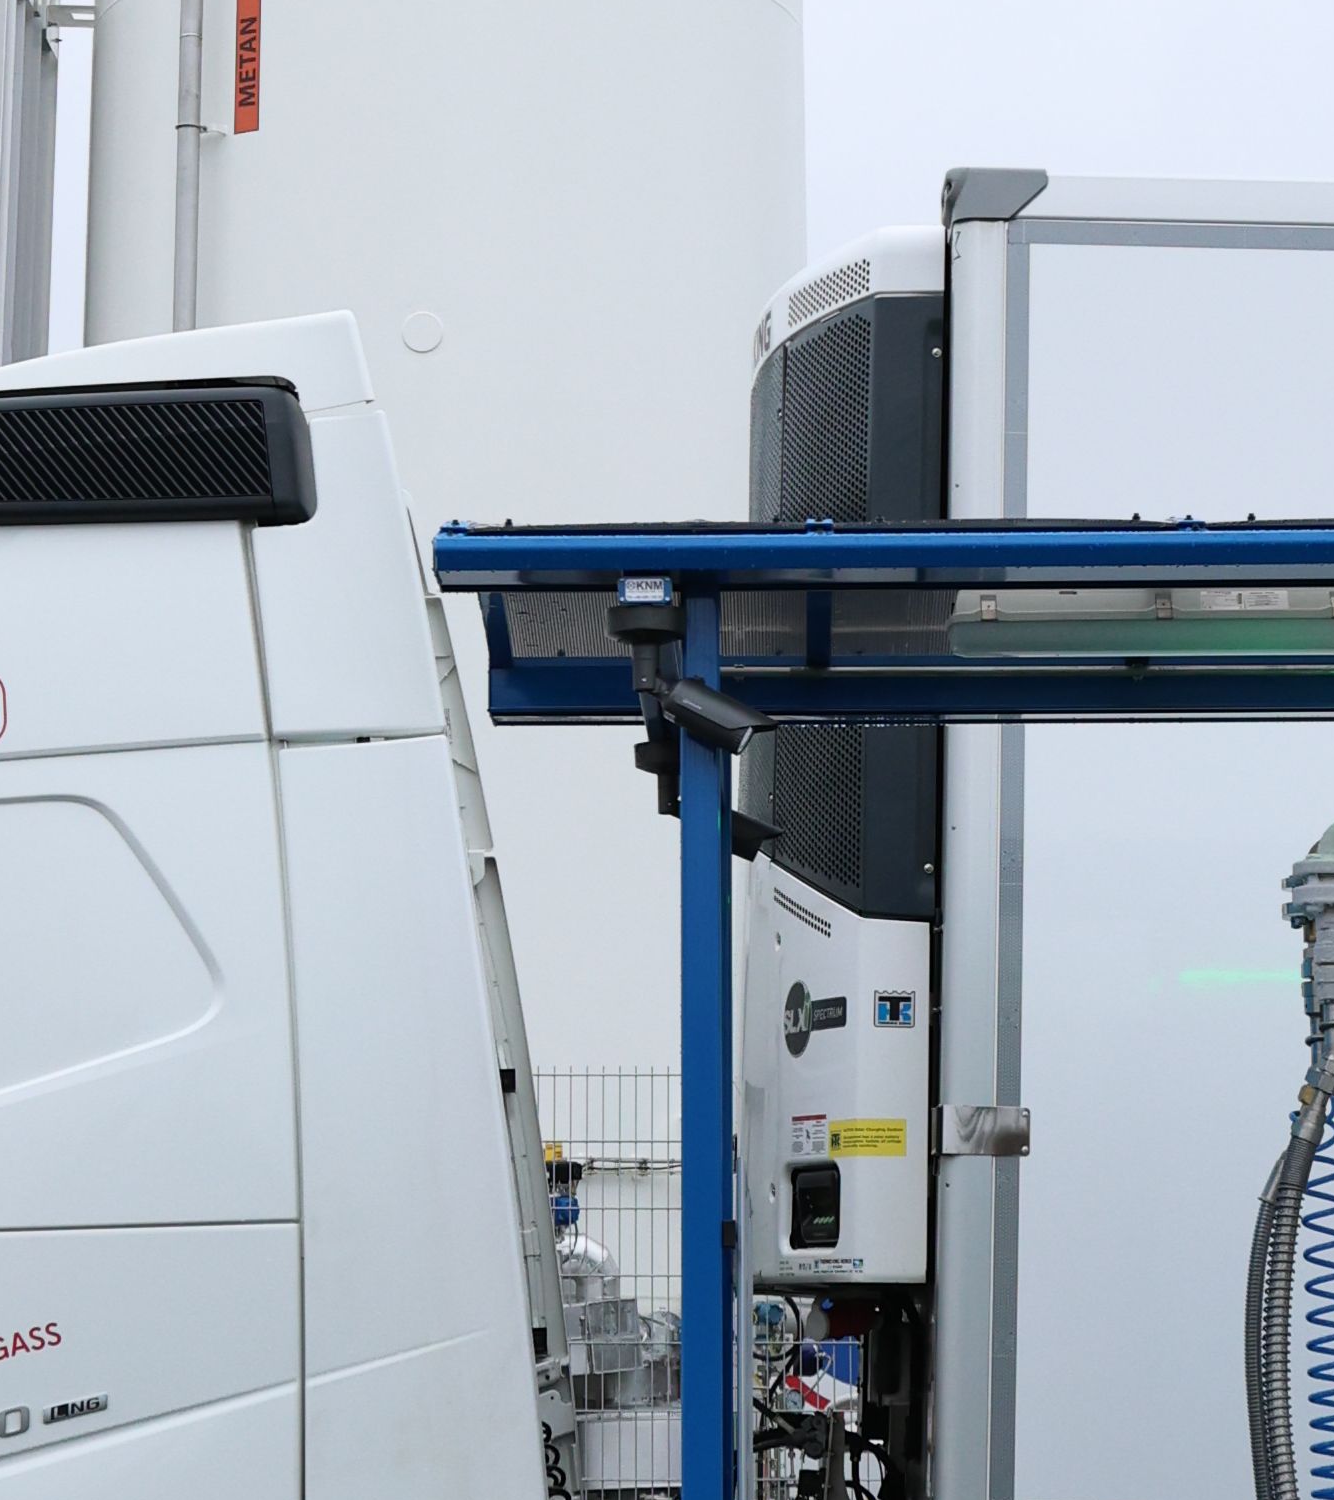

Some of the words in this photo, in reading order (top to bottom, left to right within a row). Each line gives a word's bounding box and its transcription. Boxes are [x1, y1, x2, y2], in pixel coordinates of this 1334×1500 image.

[238, 16, 257, 107] METAN
[637, 581, 663, 590] KNM
[813, 1006, 843, 1021] SPECTRUM
